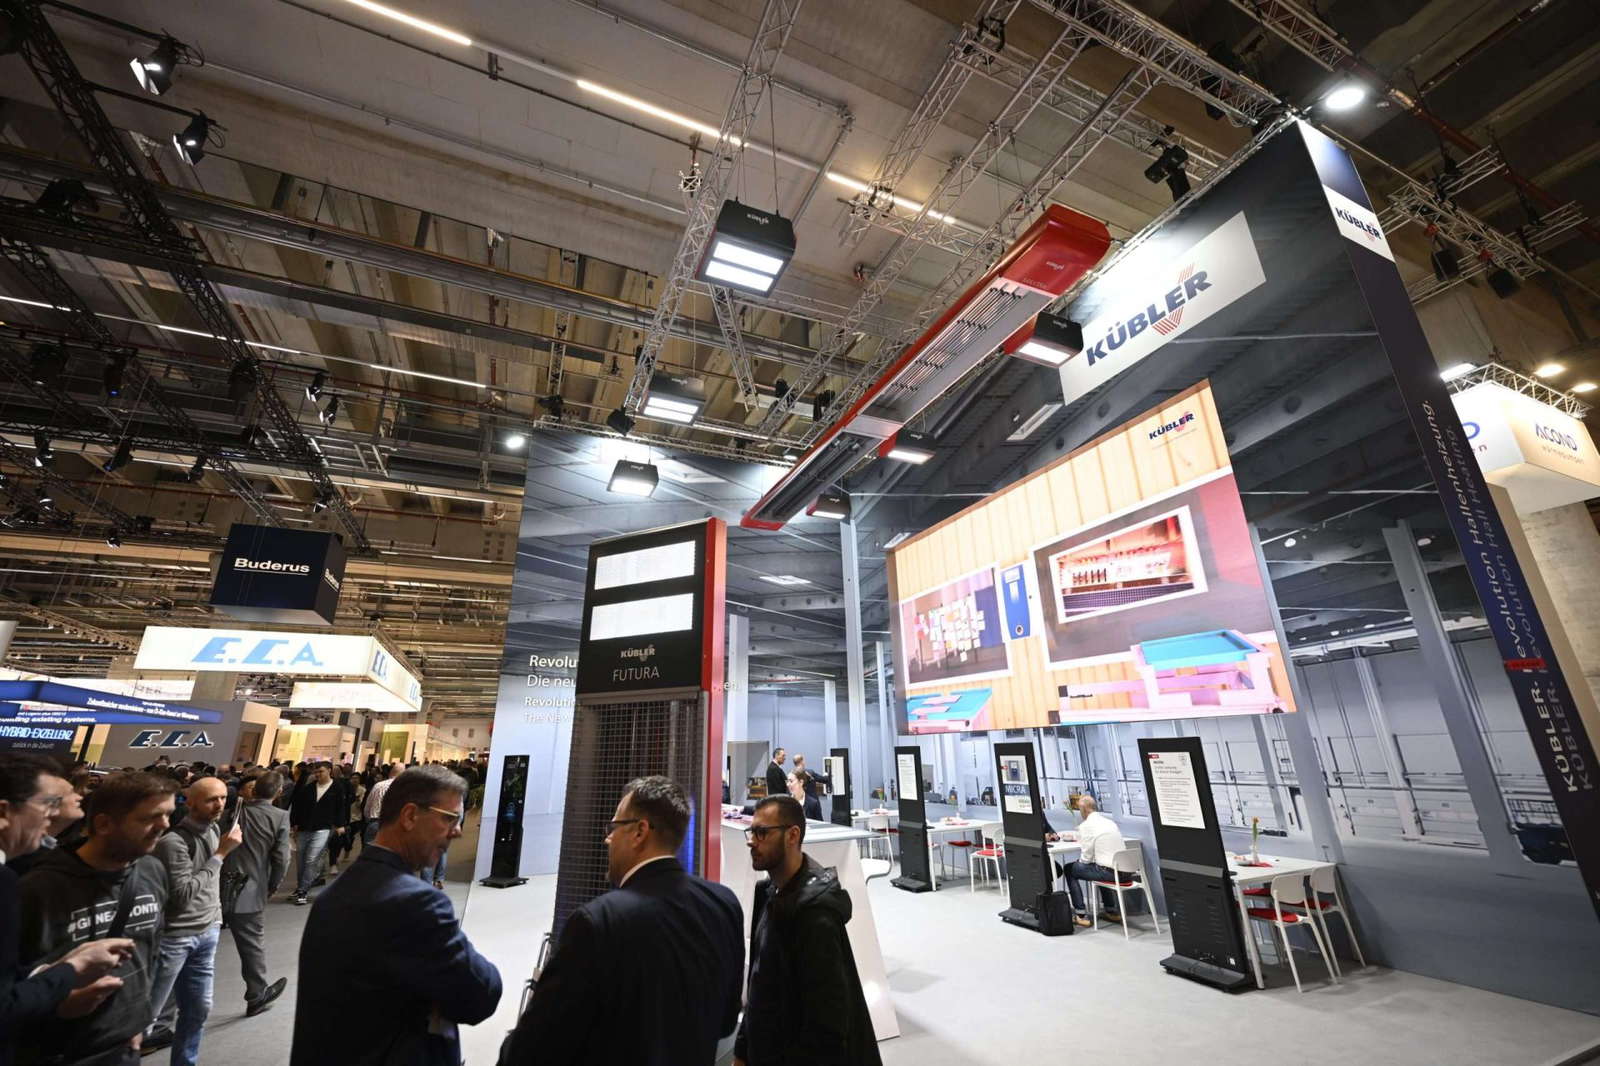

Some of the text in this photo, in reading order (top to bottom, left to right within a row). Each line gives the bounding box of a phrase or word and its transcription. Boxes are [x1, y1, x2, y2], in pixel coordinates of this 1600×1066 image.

[1335, 207, 1381, 240] KÜBLER
[1086, 271, 1212, 366] KÜBLER
[1149, 413, 1194, 440] KÜBLER
[1535, 423, 1578, 452] ACOND
[1422, 400, 1483, 545] Hallenheizung.
[234, 557, 310, 573] Buderus
[620, 646, 656, 659] KÜBLER
[527, 674, 550, 687] Die
[612, 665, 660, 681] FUTURA
[1531, 681, 1578, 792] KÜBLER.
[1547, 681, 1593, 790] KÜBLER.
